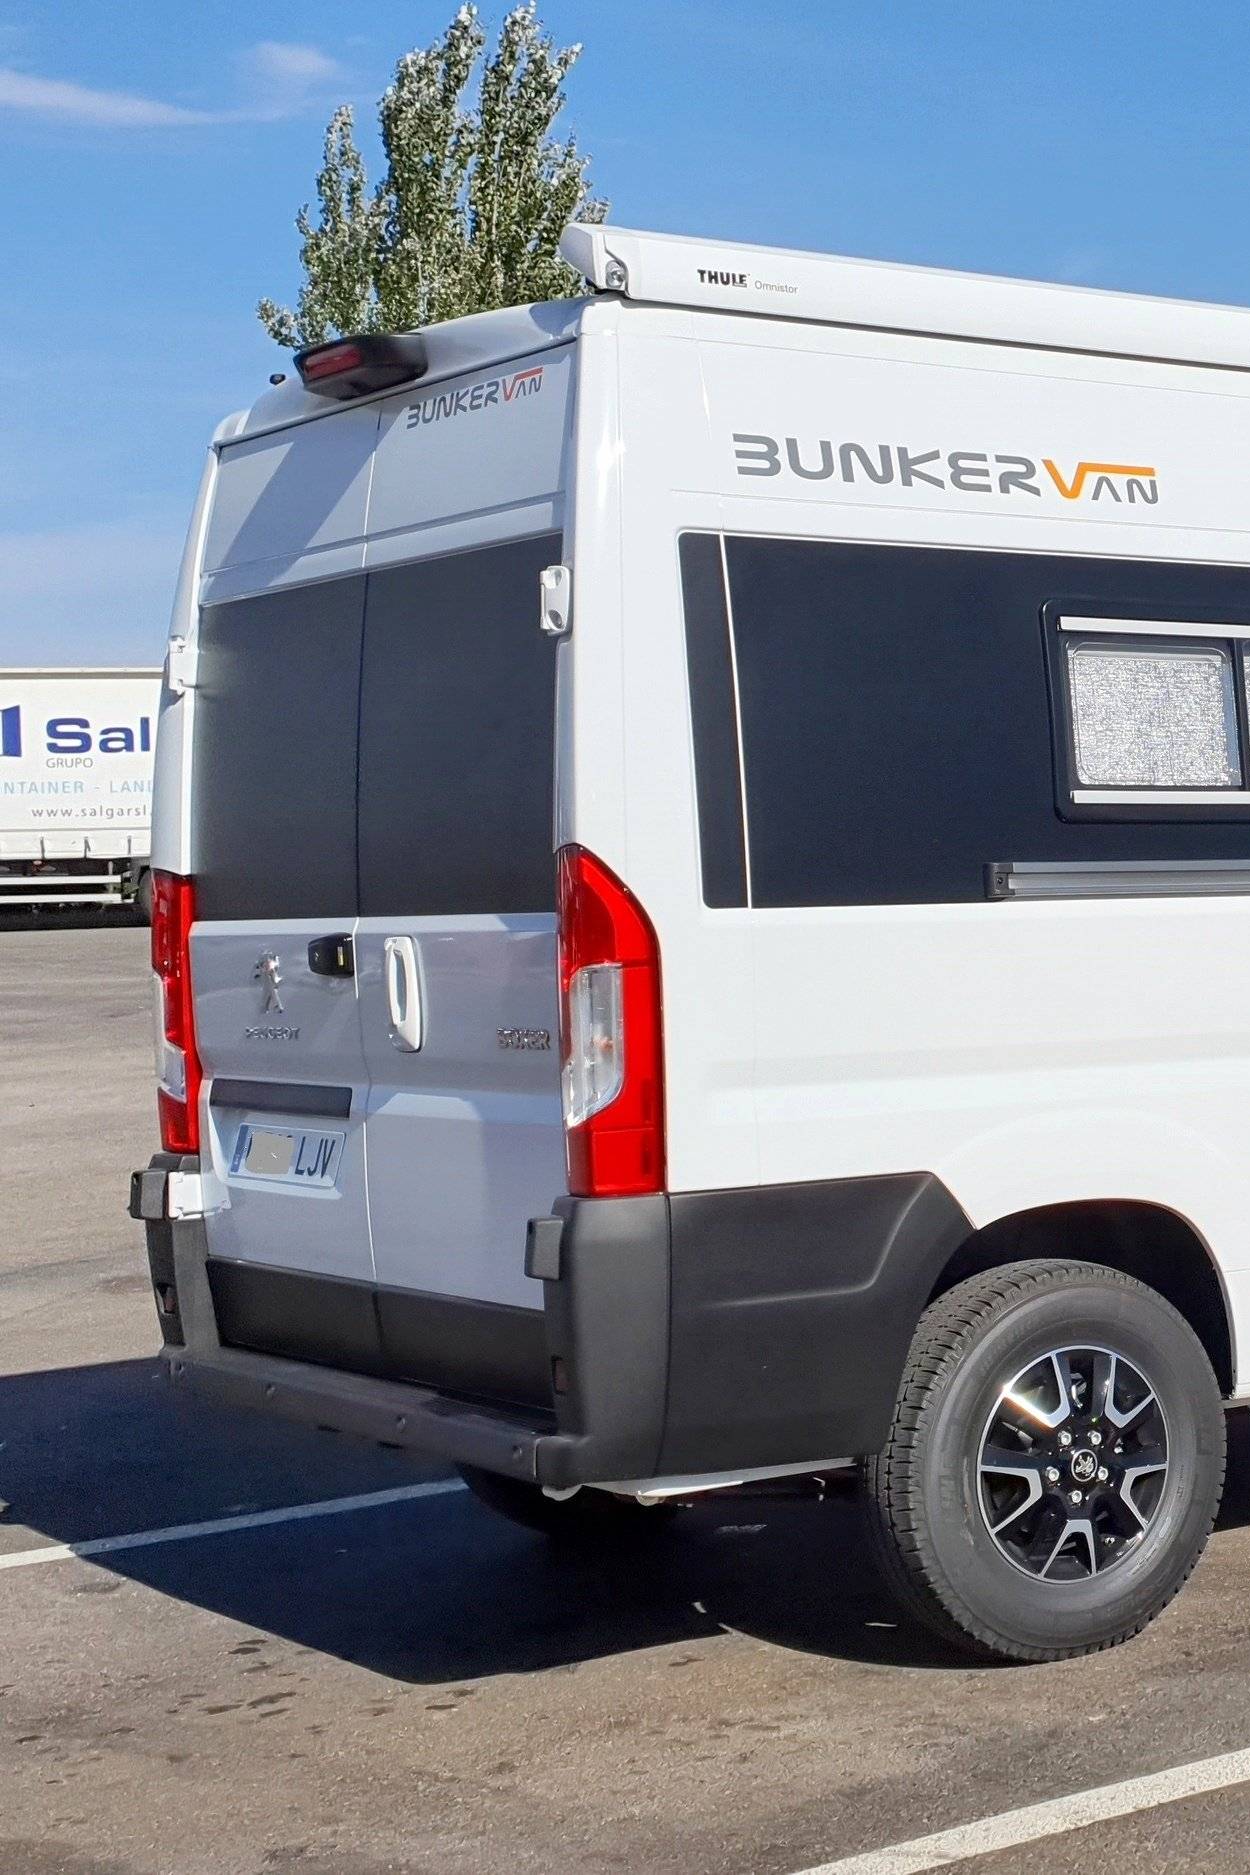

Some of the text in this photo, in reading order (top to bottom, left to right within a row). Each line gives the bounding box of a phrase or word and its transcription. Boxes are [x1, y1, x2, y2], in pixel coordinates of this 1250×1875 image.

[697, 269, 799, 294] THULE Omnistor
[406, 366, 544, 430] BUNKERVAN
[732, 432, 1159, 505] BUNKERVAN
[46, 757, 94, 769] GRUPO
[0, 780, 84, 794] NTAINER
[110, 780, 152, 793] LAN
[294, 1135, 336, 1179] LJV
